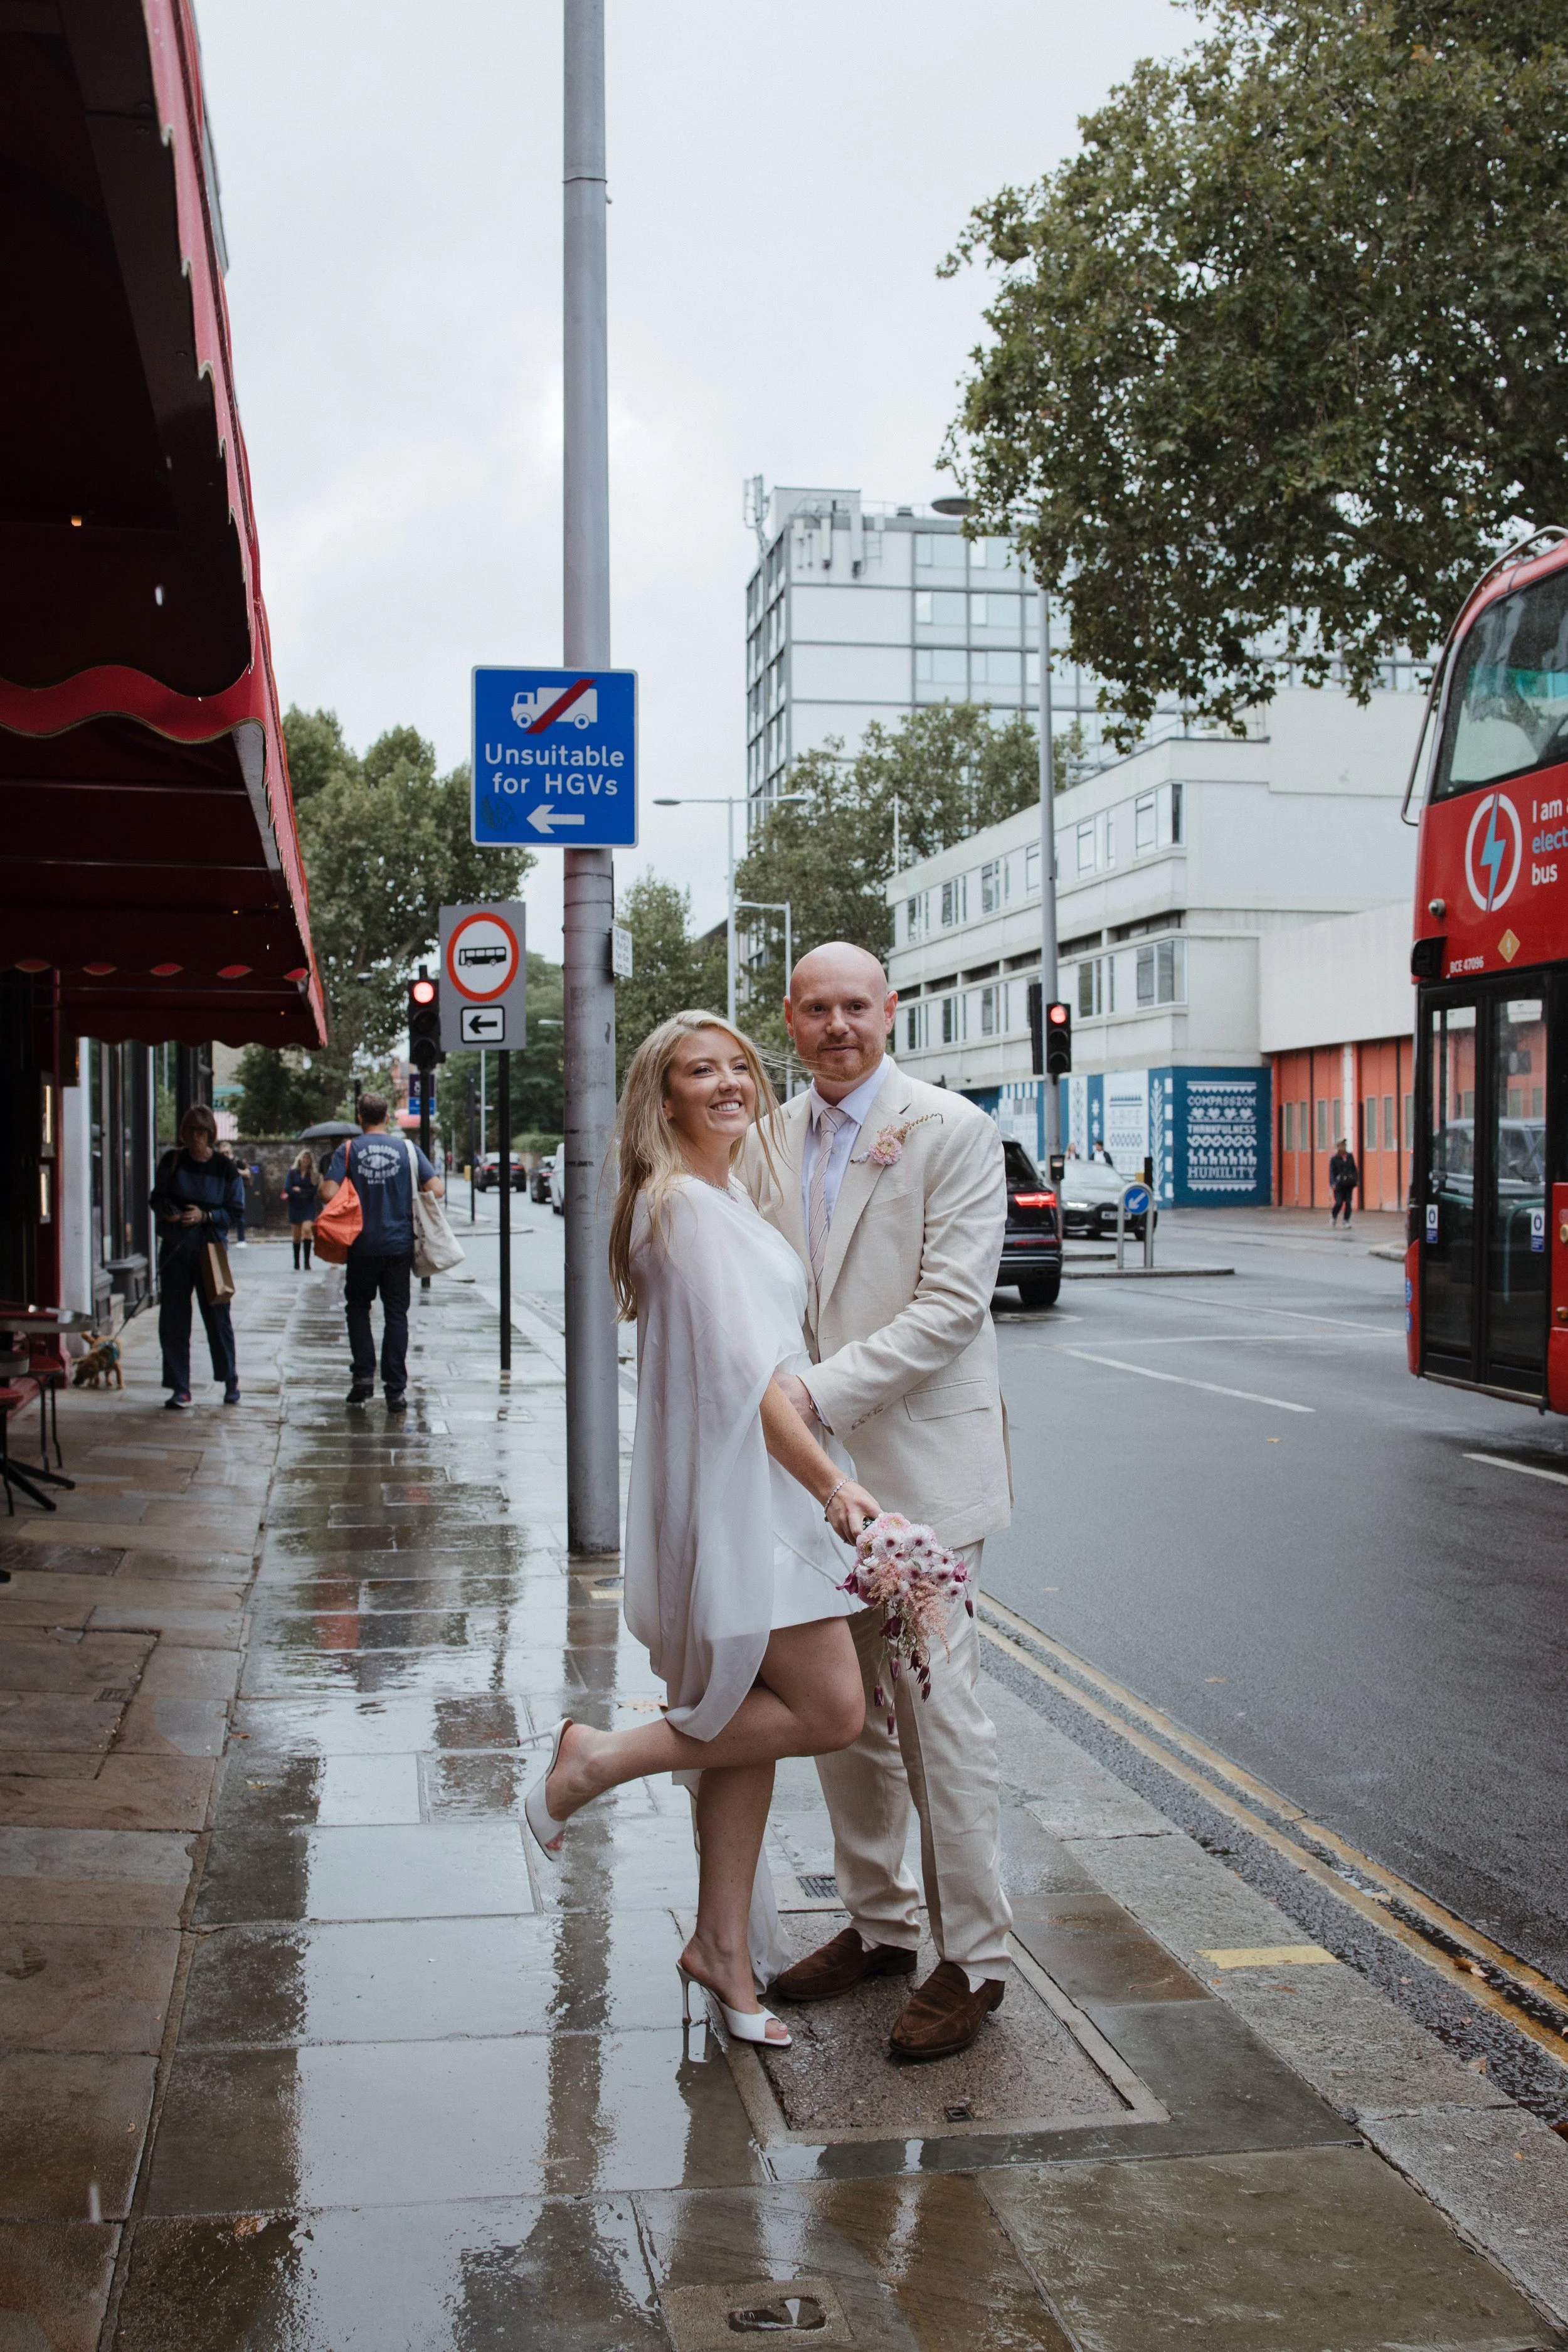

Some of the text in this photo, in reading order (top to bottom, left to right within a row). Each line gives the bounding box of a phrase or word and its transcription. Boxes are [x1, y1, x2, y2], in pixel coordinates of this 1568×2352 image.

[485, 743, 625, 767] Unsuitable
[492, 771, 618, 796] for HGVs
[1532, 800, 1537, 824] I
[1540, 798, 1563, 822] am
[1532, 862, 1558, 886] bus
[1449, 960, 1463, 973] BCE
[1187, 1095, 1256, 1106] COMPASSION
[1187, 1123, 1256, 1135] THANKFULNESS
[1187, 1166, 1256, 1179] HUMILITY
